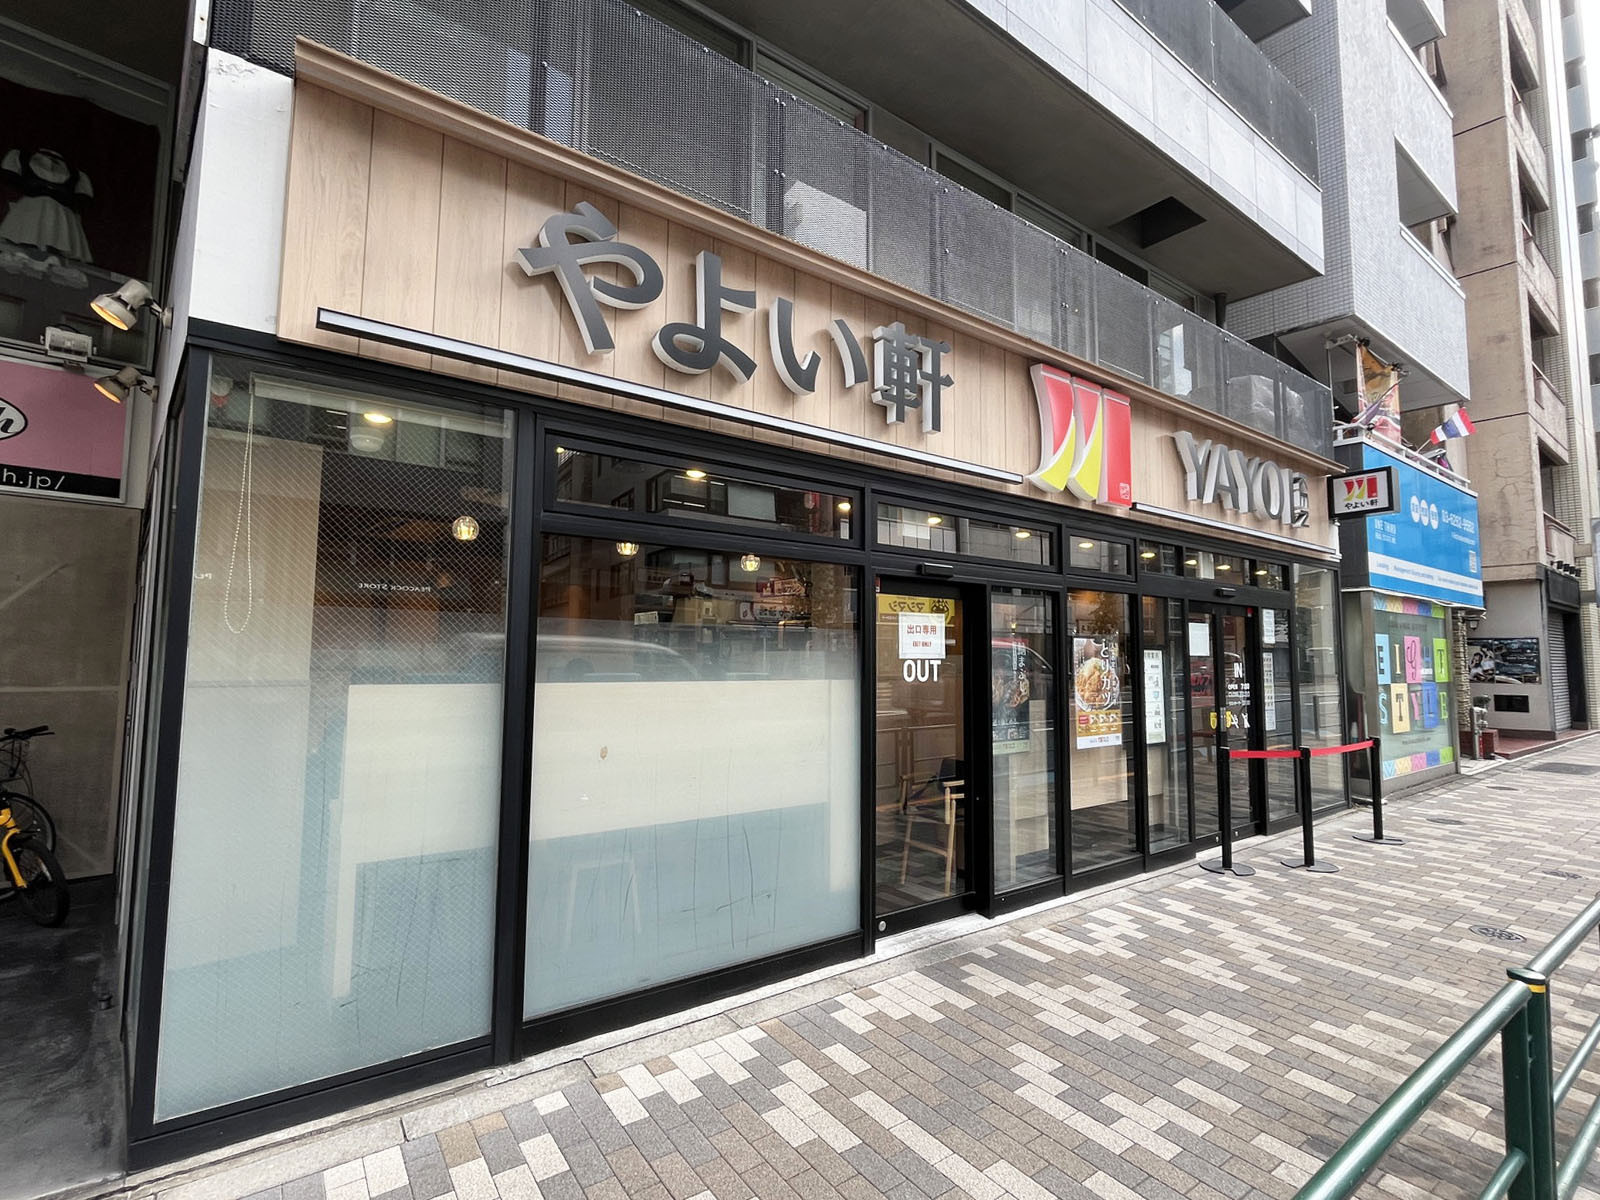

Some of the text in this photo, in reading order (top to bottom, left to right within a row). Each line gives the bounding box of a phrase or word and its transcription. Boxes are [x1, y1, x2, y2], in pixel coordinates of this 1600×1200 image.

[513, 201, 954, 434] やよい軒
[1174, 431, 1294, 525] YAYOI
[1344, 499, 1379, 510] やよい軒
[906, 624, 937, 635] 出口専用
[903, 659, 941, 683] OUT
[1234, 662, 1243, 678] IN
